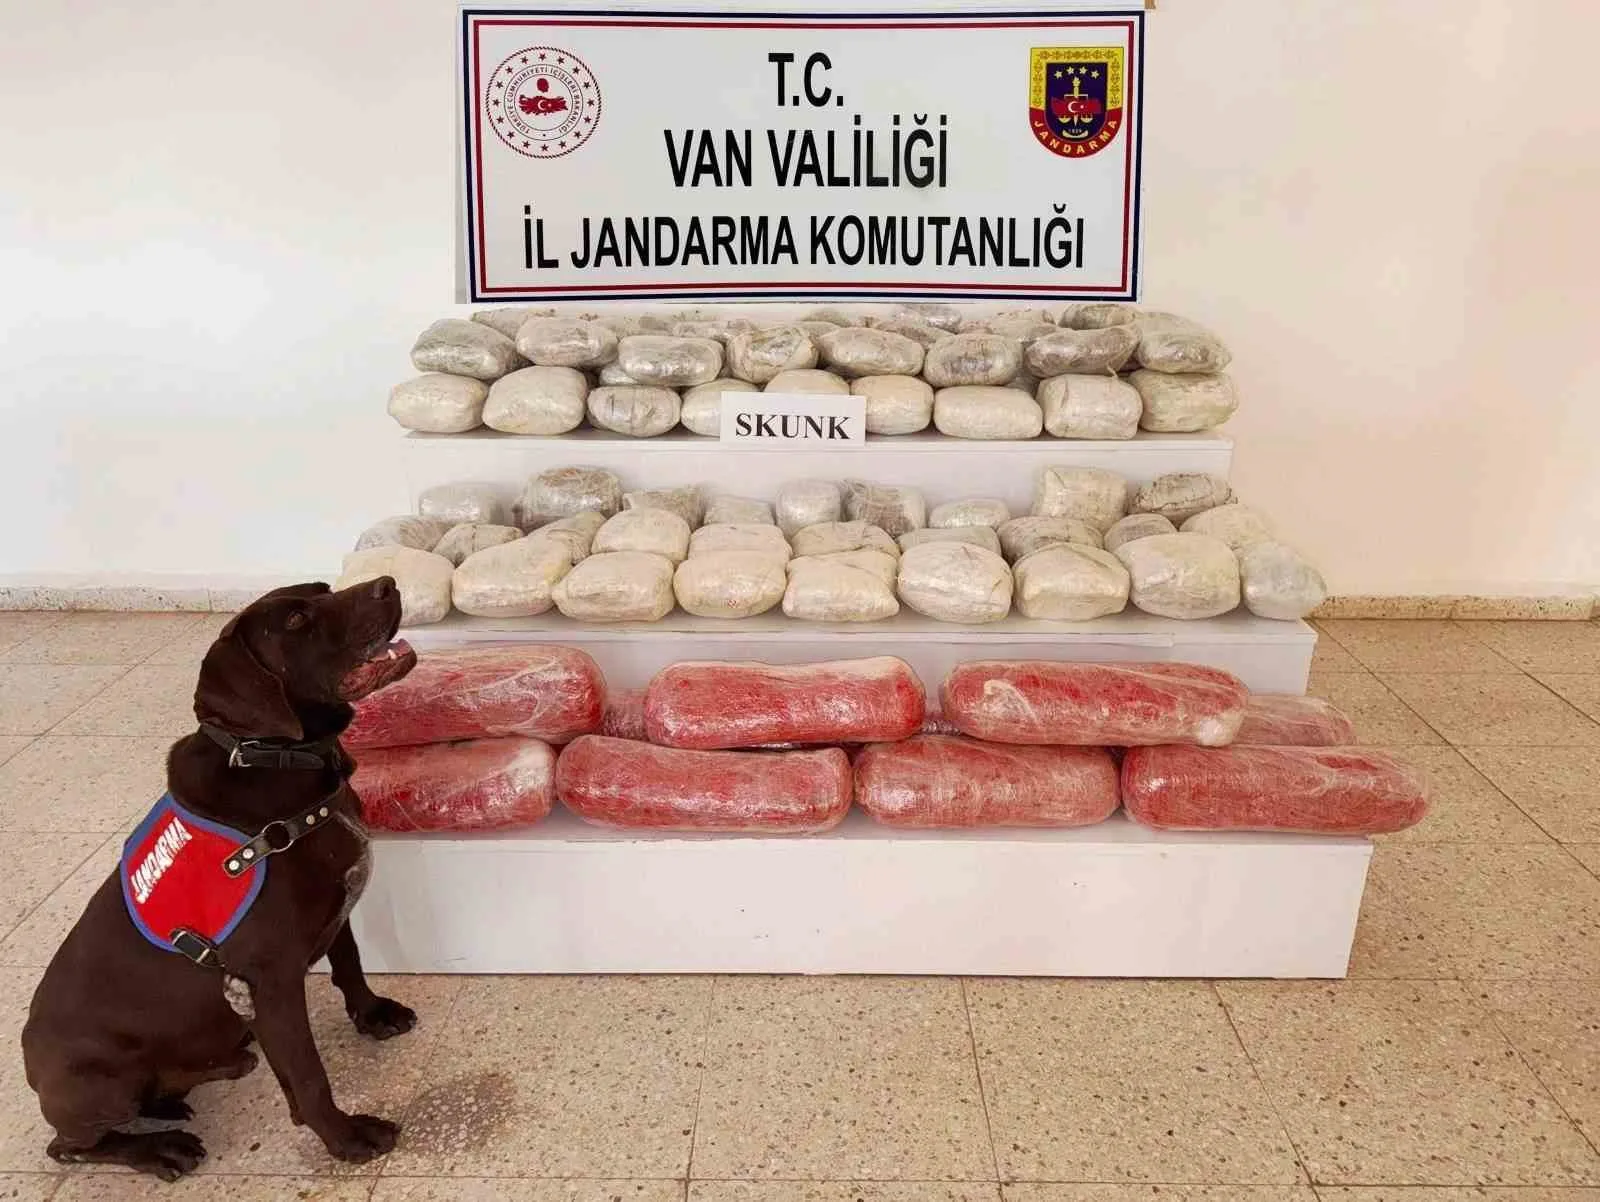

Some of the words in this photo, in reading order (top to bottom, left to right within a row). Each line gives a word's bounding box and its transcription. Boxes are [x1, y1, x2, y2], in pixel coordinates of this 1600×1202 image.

[767, 52, 844, 107] T.C.
[664, 129, 752, 188] VAN
[767, 114, 947, 189] VALİLİĞİ
[1034, 120, 1117, 154] JANDARMA
[524, 205, 559, 269] İL
[571, 215, 799, 269] JANDARMA
[810, 203, 1084, 269] KOMUTANLIĞI
[735, 413, 850, 440] SKUNK
[131, 816, 193, 904] JANDARMA
